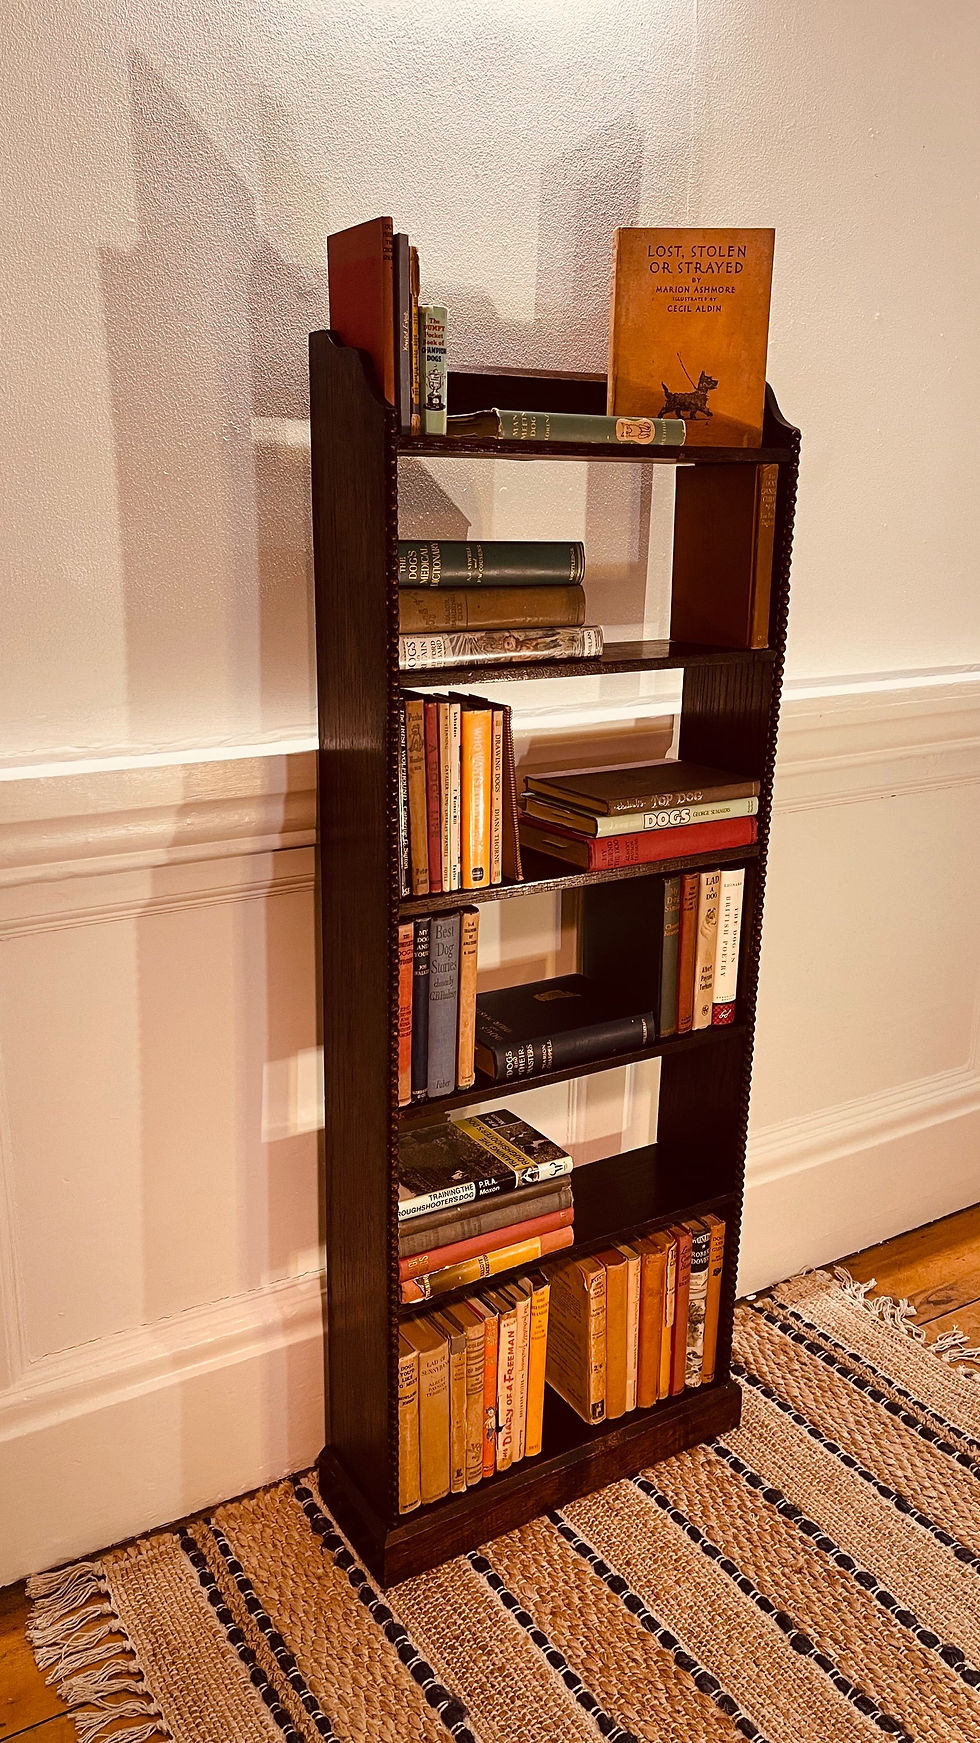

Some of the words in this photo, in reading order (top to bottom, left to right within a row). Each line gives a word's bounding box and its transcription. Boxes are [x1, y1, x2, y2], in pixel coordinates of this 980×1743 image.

[648, 245, 685, 259] LOST,
[691, 245, 747, 258] STOLEN
[650, 262, 673, 274] OR
[678, 261, 744, 274] STRAYED
[656, 286, 690, 294] MARION
[693, 286, 736, 294] ASHMORE
[423, 324, 446, 332] DUMPY
[424, 332, 444, 340] Pocket
[408, 549, 418, 580] DOG'S
[420, 545, 429, 585] MEDICAL
[406, 641, 416, 668] OGS
[428, 744, 437, 754] A
[650, 792, 674, 808] TOP
[677, 792, 703, 806] DOG
[644, 808, 691, 829] DOGS
[706, 876, 720, 886] LAD
[706, 892, 718, 900] DOG
[418, 928, 428, 936] MY
[436, 925, 454, 940] Best
[437, 943, 454, 961] Dog
[720, 940, 728, 977] POETRY
[430, 960, 458, 974] Stories
[436, 1080, 451, 1090] Faber
[478, 1178, 498, 1188] P.R.A.
[428, 1186, 461, 1202] TRAINING
[460, 1184, 474, 1194] THE
[458, 1192, 474, 1201] DOG
[504, 1330, 515, 1384] FREEMAN
[426, 1360, 438, 1368] LAD
[506, 1393, 513, 1406] OF
[502, 1408, 514, 1446] DIARY
